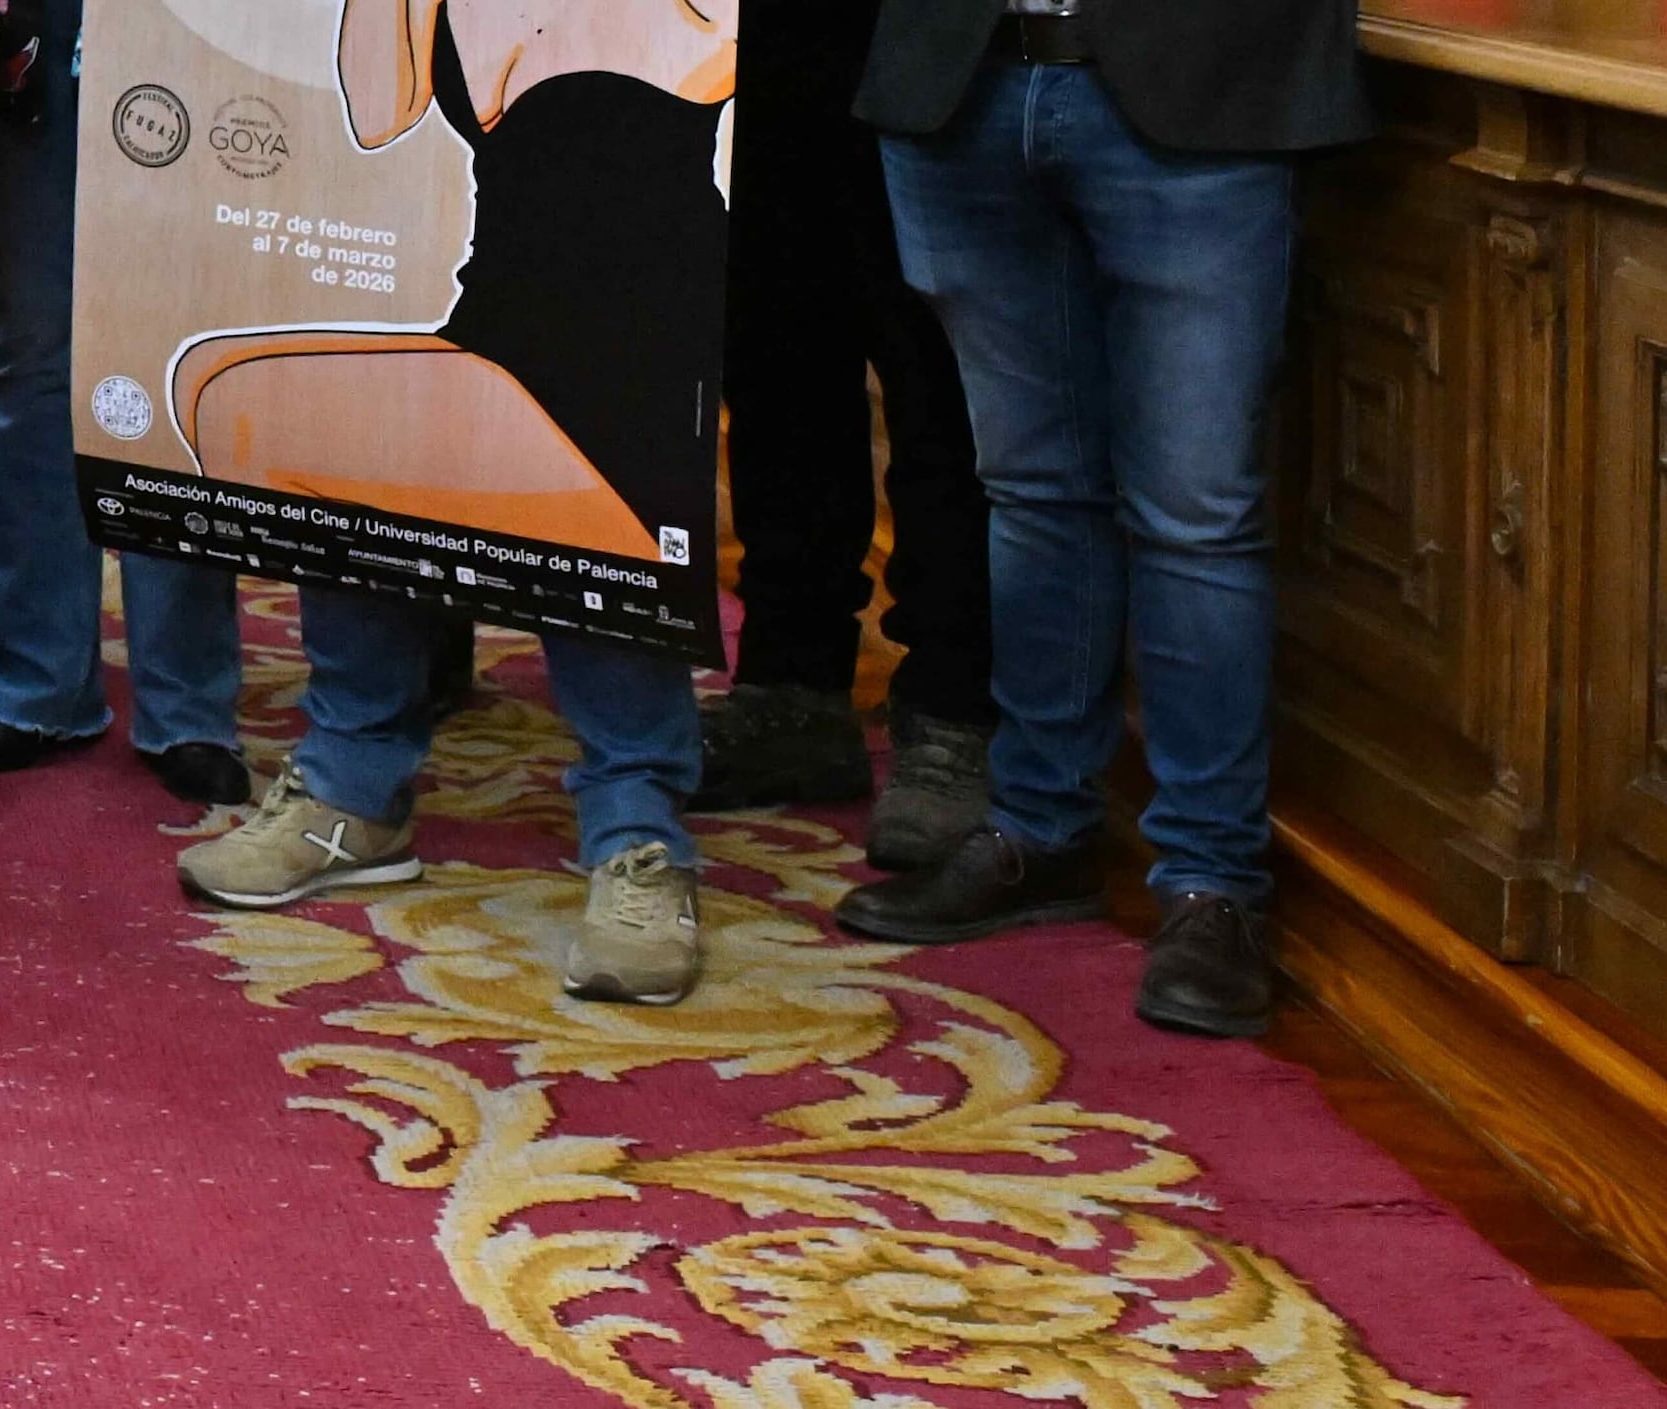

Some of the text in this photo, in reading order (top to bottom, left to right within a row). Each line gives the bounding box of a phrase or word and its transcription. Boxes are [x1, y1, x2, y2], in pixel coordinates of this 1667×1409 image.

[126, 111, 176, 142] FUGAZ
[209, 126, 290, 158] GOYA
[216, 204, 396, 246] Del 27 de febrero
[253, 235, 395, 268] al 7 de marzo
[312, 266, 395, 293] de 2026
[125, 474, 211, 503] Asociación
[215, 492, 276, 515] Amigos
[281, 503, 306, 520] del
[311, 509, 349, 530] Cine
[366, 519, 467, 552] Universidad
[474, 540, 543, 566] Popular
[549, 555, 571, 572] de
[578, 559, 657, 589] Palencia
